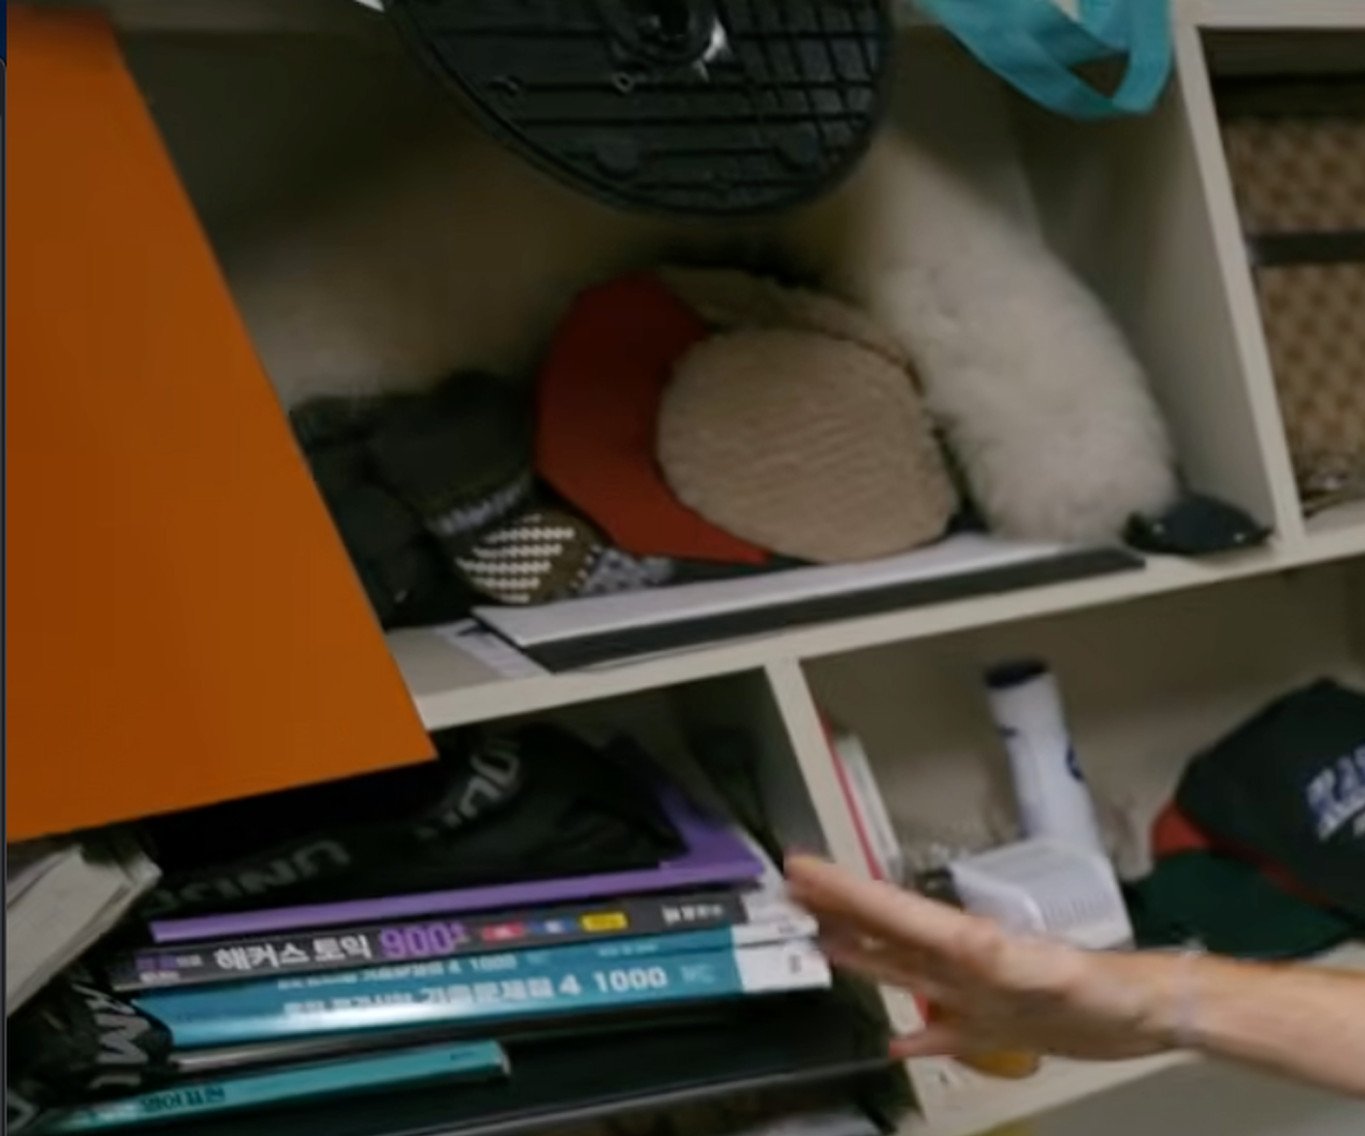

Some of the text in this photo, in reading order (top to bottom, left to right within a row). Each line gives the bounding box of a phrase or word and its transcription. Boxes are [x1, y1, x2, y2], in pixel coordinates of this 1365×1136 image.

[214, 942, 309, 972] 해커스
[313, 935, 371, 962] 토익
[559, 971, 583, 998] 4
[594, 966, 668, 994] 1000
